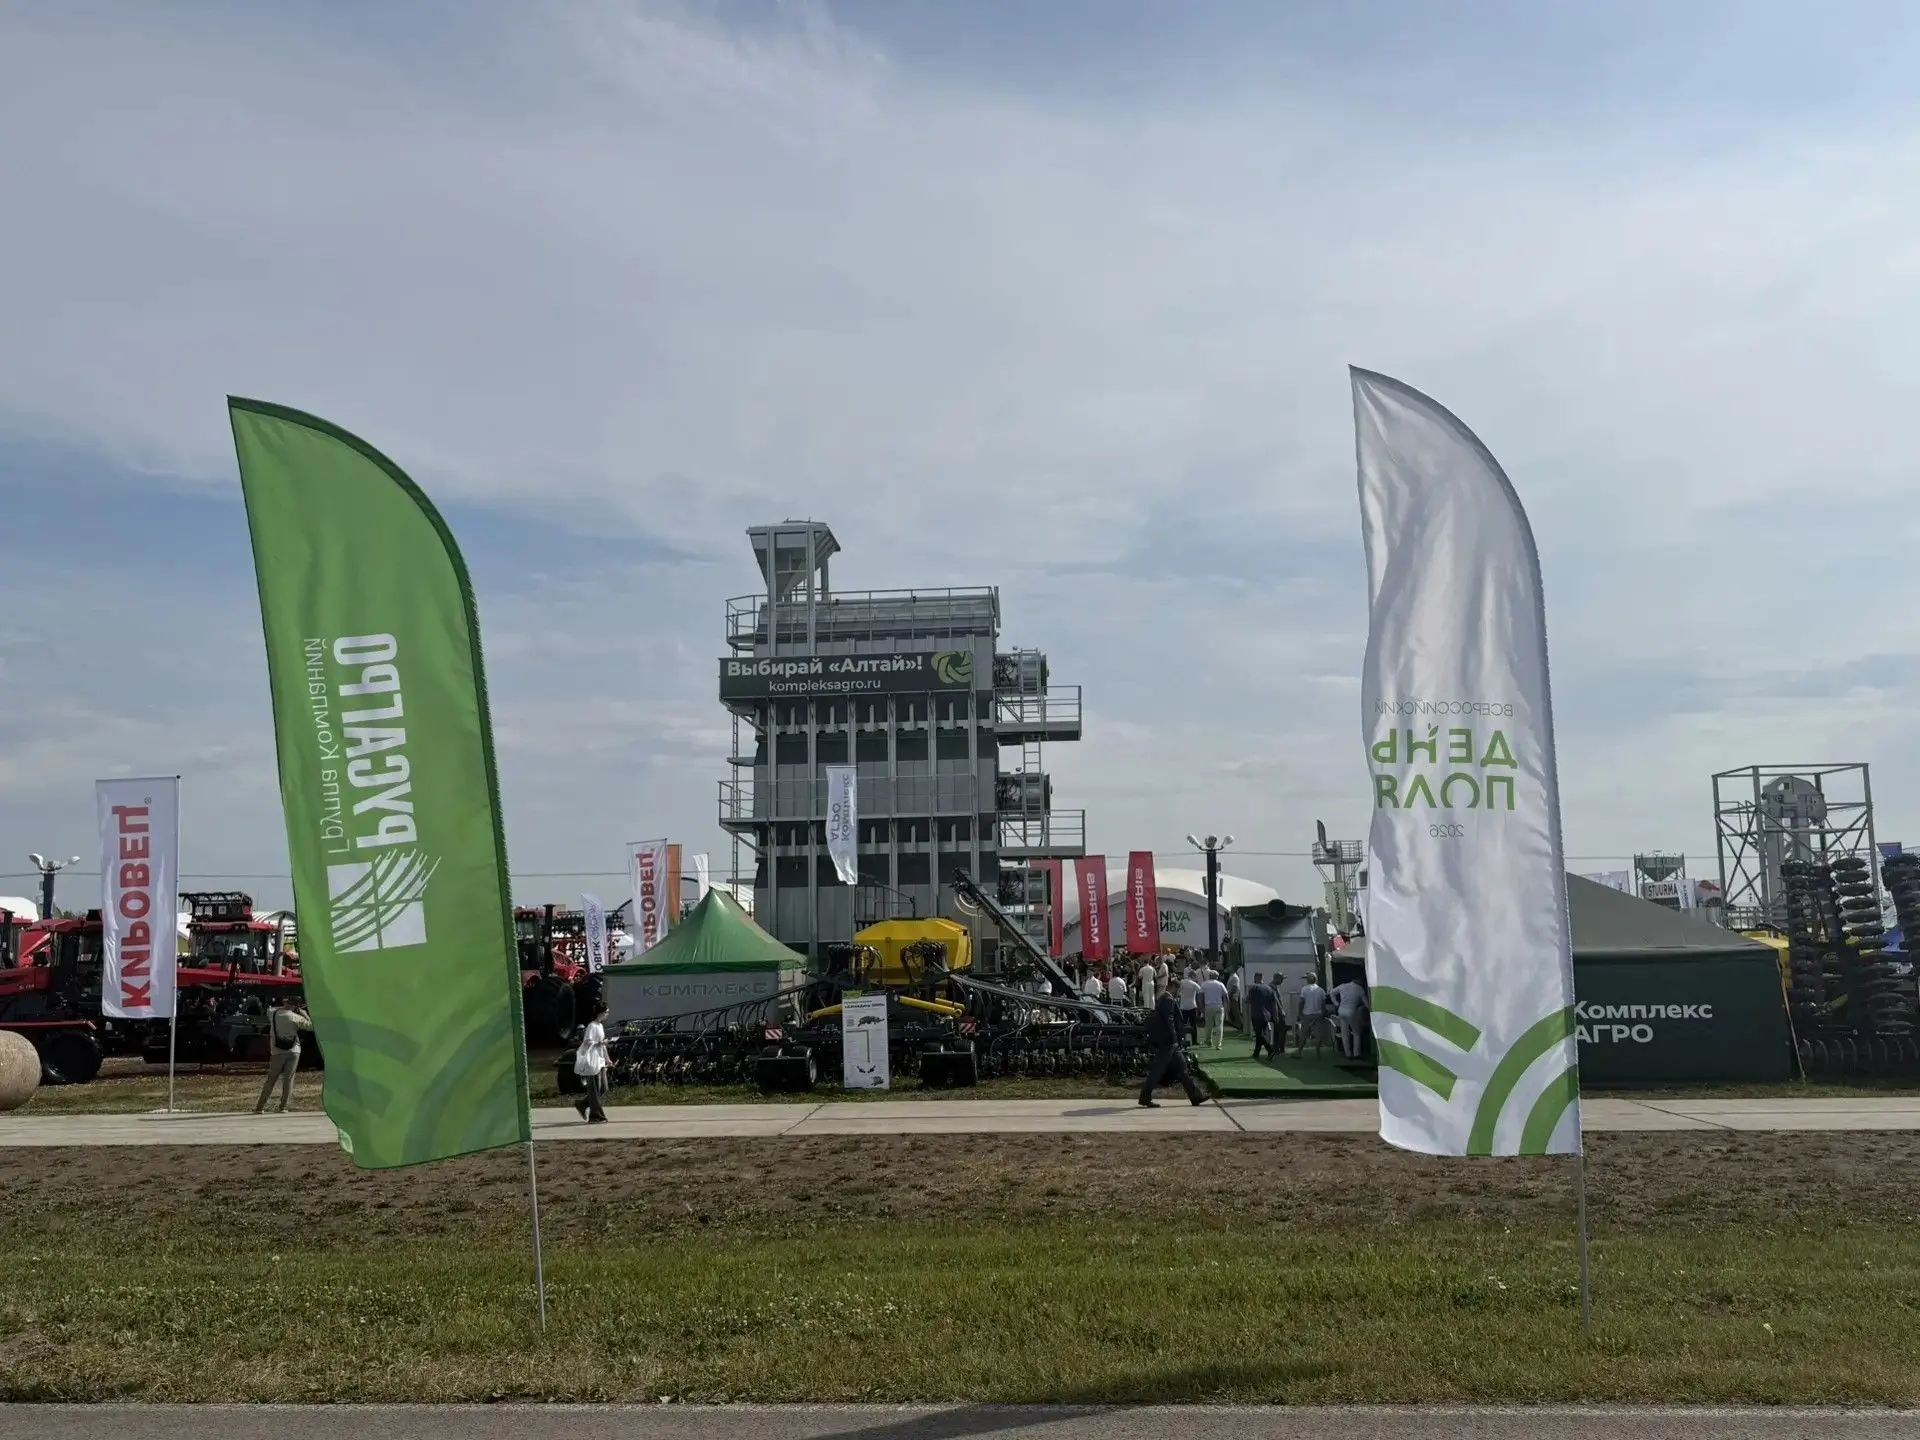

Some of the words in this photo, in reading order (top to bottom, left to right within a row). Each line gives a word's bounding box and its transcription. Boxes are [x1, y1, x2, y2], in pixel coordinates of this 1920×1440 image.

[727, 658, 823, 678] Выбирай
[828, 655, 923, 673] «Алтай»!
[769, 678, 881, 692] kompleksagro.ru
[1647, 882, 1679, 898] STUURMA
[1160, 910, 1191, 922] NIVA
[1160, 921, 1186, 933] ИВА
[642, 982, 768, 997] КОМПЛЕКС
[1574, 1000, 1713, 1019] Комплекс
[1575, 1023, 1654, 1043] АГРО
